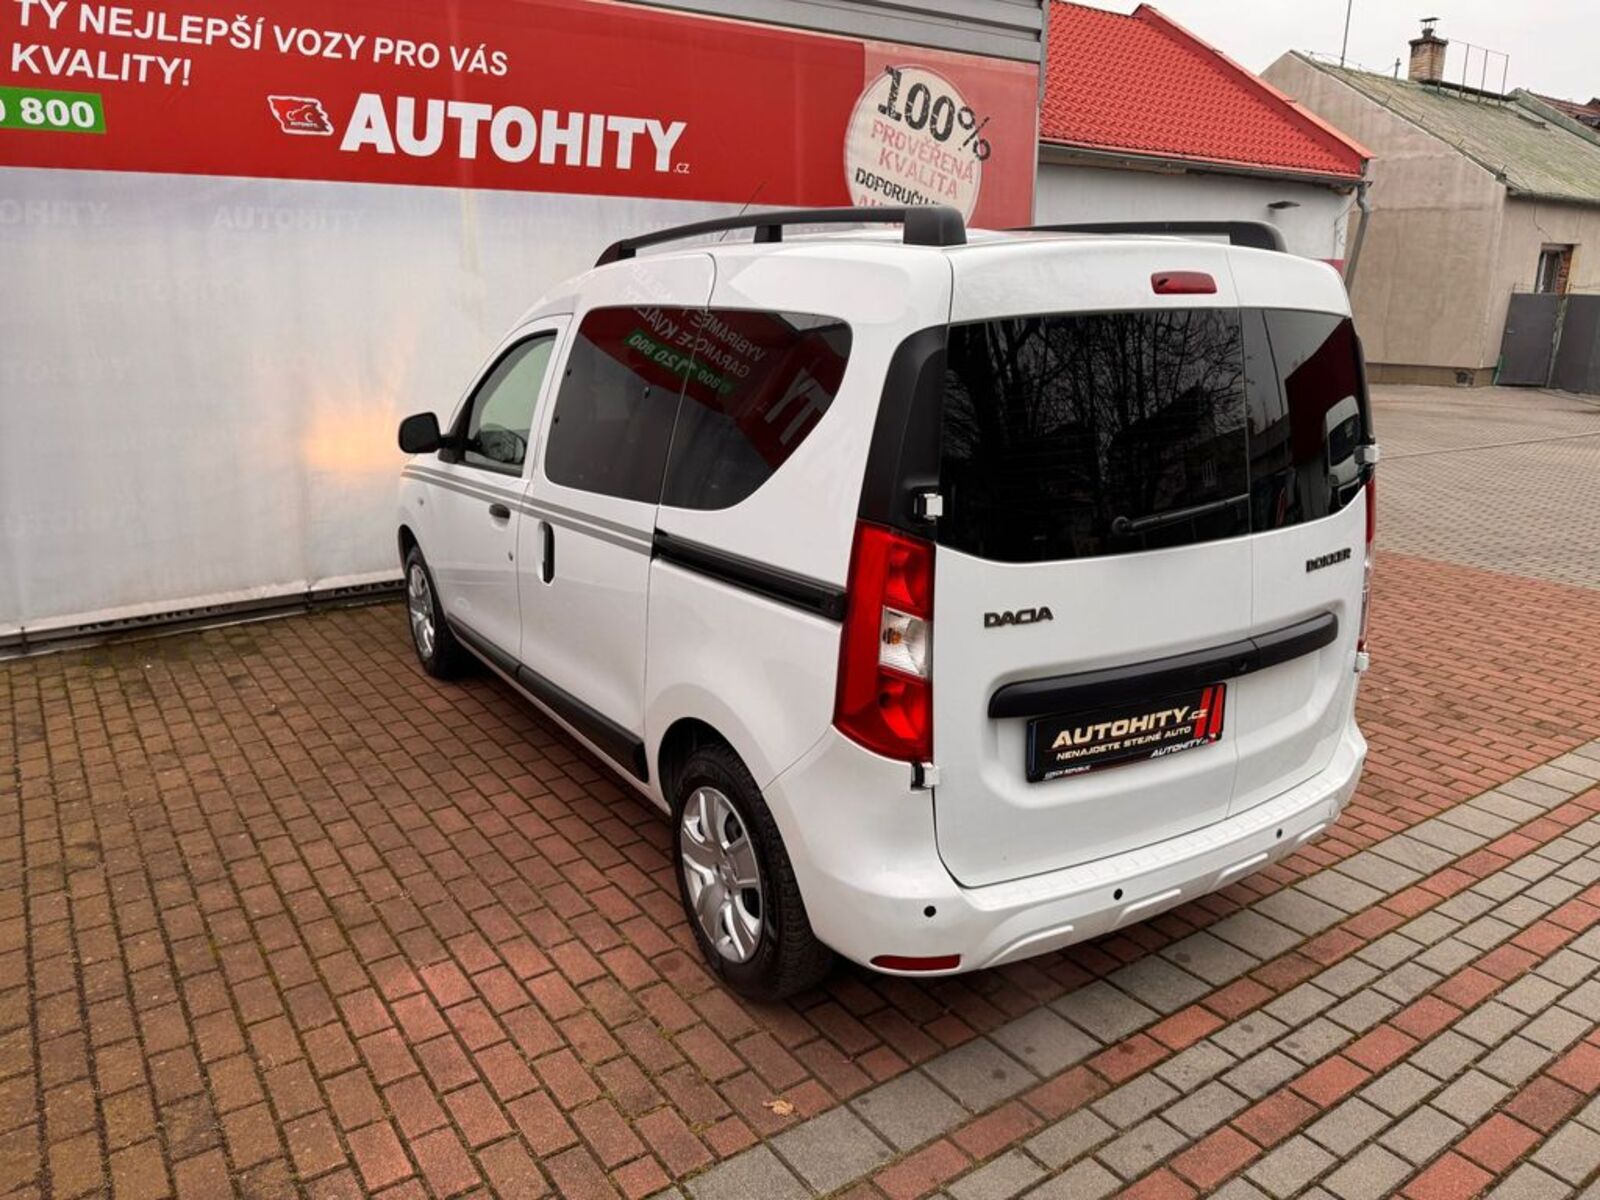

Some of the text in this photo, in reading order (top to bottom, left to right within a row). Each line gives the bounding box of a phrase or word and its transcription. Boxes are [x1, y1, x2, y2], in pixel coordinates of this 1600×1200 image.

[14, 0, 509, 77] TY NEJLEPŠÍ VOZY PRO VÁS
[11, 42, 192, 87] KVALITY!
[19, 97, 95, 128] 800
[877, 65, 992, 162] 100%
[871, 119, 976, 184] PROVĚŘENÁ
[878, 147, 959, 200] KVALITA
[854, 167, 941, 206] DOPORUČ
[984, 606, 1054, 629] DACIA
[1056, 725, 1192, 762] NENAJDETE STEJNÉ AUTO
